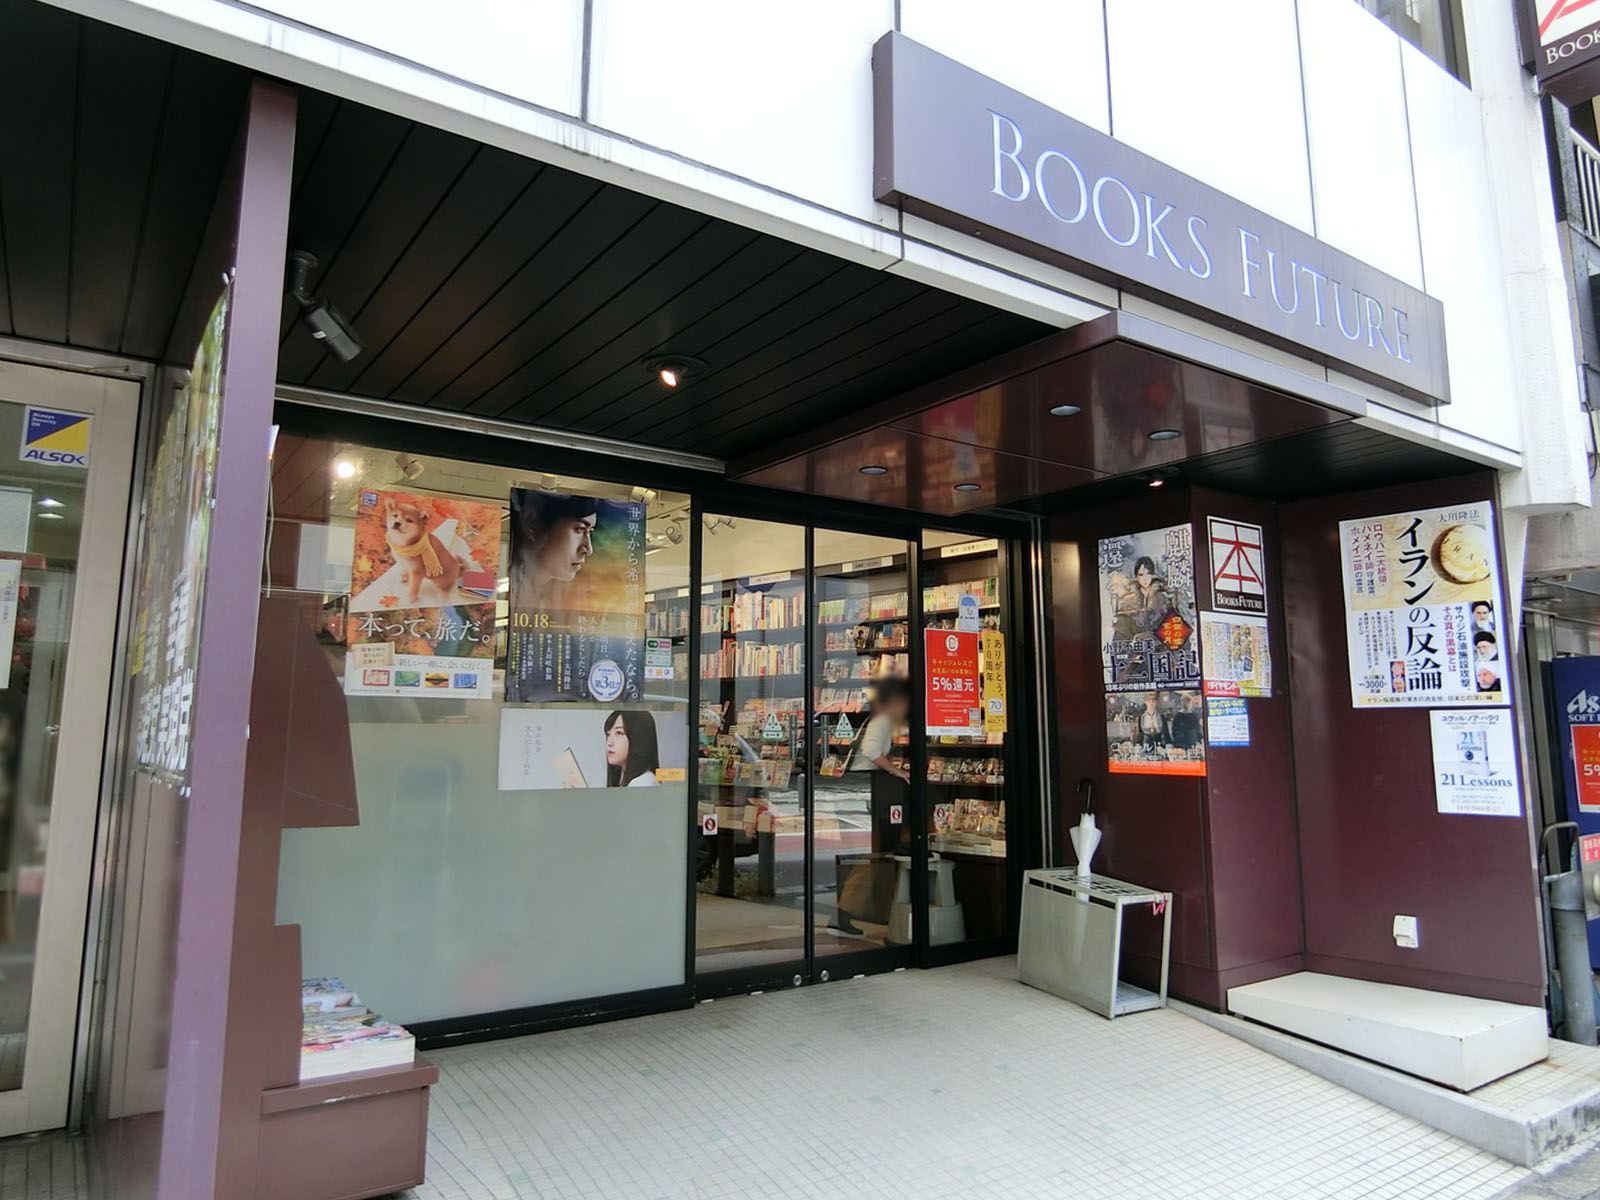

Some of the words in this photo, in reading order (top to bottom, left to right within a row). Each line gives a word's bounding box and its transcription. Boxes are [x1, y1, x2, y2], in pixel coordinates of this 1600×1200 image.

[986, 108, 1212, 279] BOOKS
[1237, 226, 1414, 364] FUTURE
[25, 449, 85, 466] ALSOK
[1439, 509, 1480, 523] 大川隆法
[1395, 517, 1442, 692] イランの反論
[359, 613, 491, 644] 本って、旅だ。
[513, 612, 549, 629] 10.18
[1103, 638, 1155, 654] 小野不由美
[1443, 606, 1457, 672] その真の黒幕とは
[1104, 651, 1201, 683] 十二国記
[932, 677, 974, 692] 5%還元
[1460, 731, 1475, 745] 21
[1440, 773, 1456, 786] 21
[1460, 774, 1513, 787] Lessons
